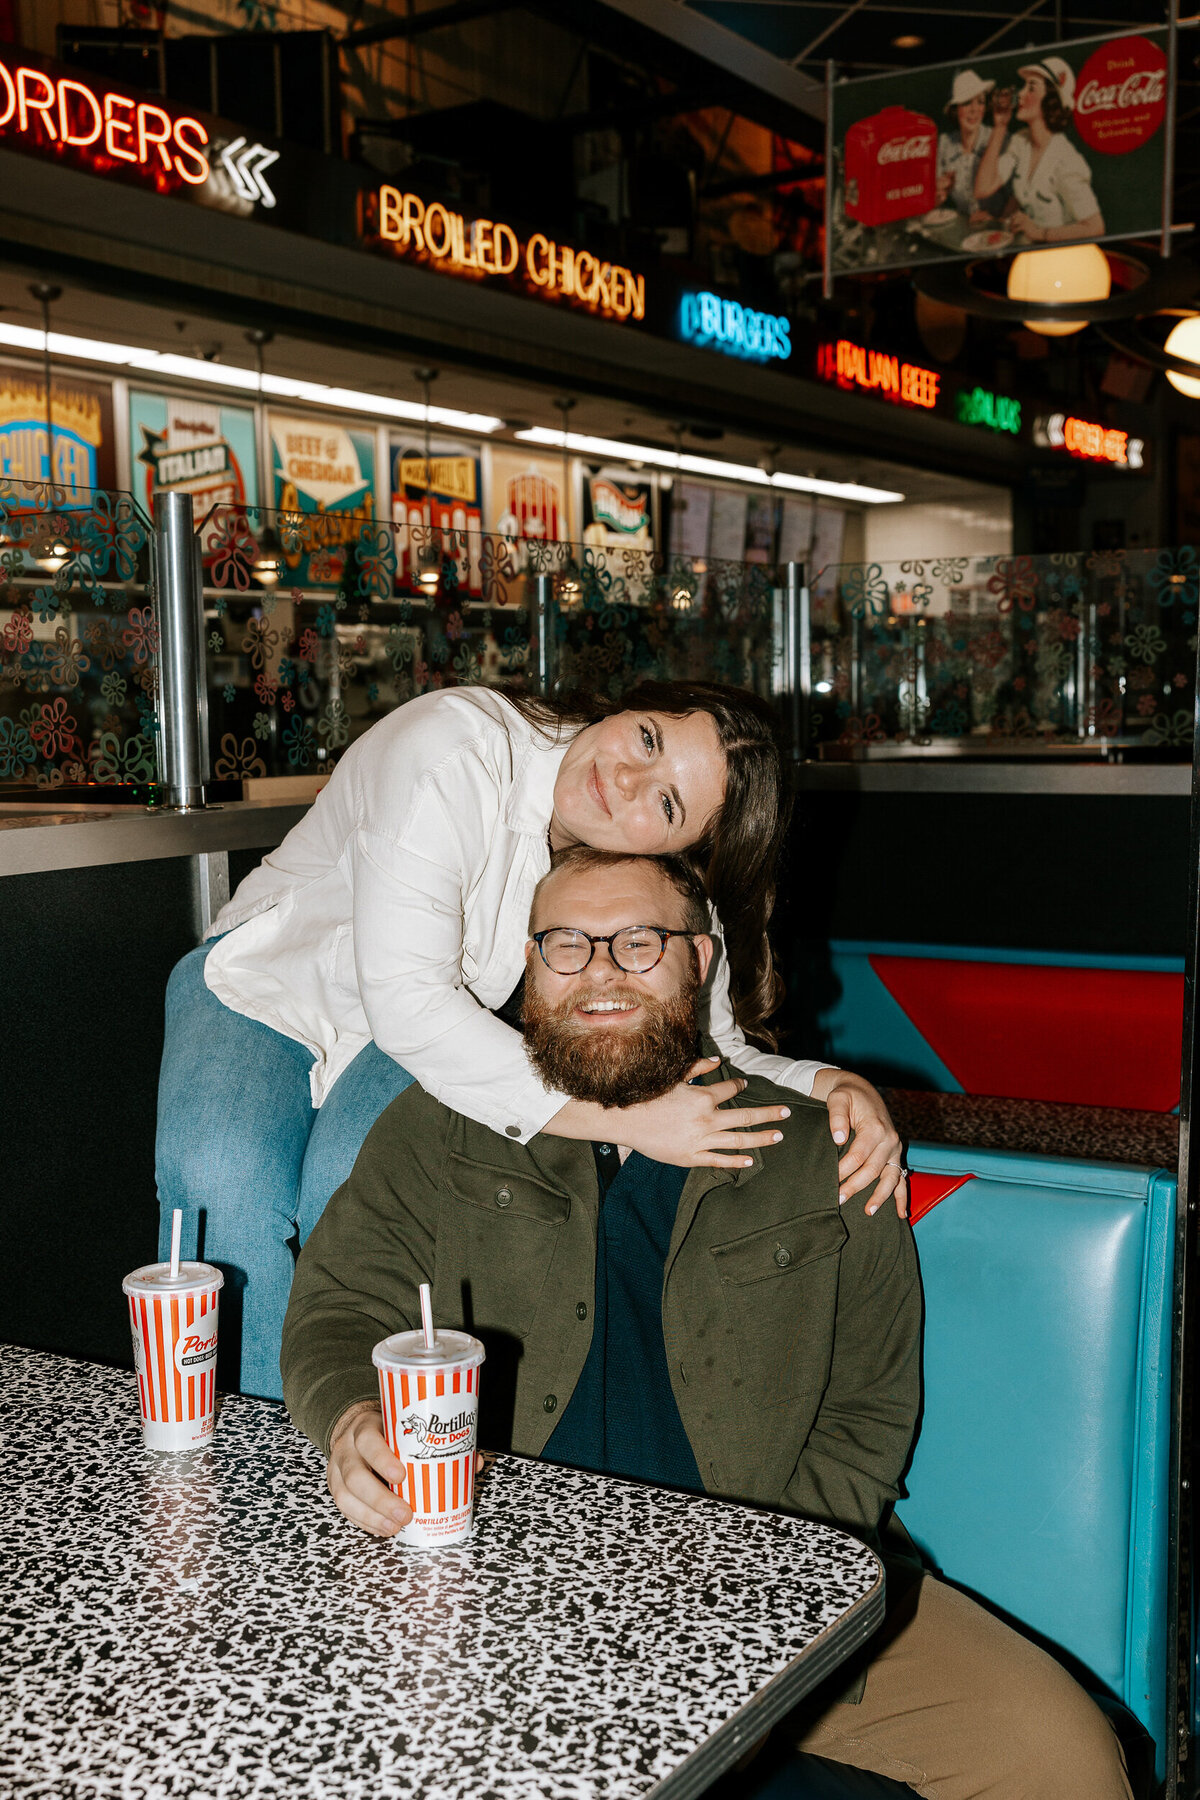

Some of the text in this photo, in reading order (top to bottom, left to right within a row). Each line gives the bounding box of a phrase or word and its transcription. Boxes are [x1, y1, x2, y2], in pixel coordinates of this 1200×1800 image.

[379, 183, 646, 322] BROILED CHICKEN
[696, 290, 792, 361] BURGERS
[836, 339, 941, 409] ITALIAN BEEF
[285, 433, 322, 457] BEEF
[158, 446, 226, 484] ITALIAN
[287, 457, 356, 485] CHEDDAR
[426, 1427, 470, 1445] HOT DOGS
